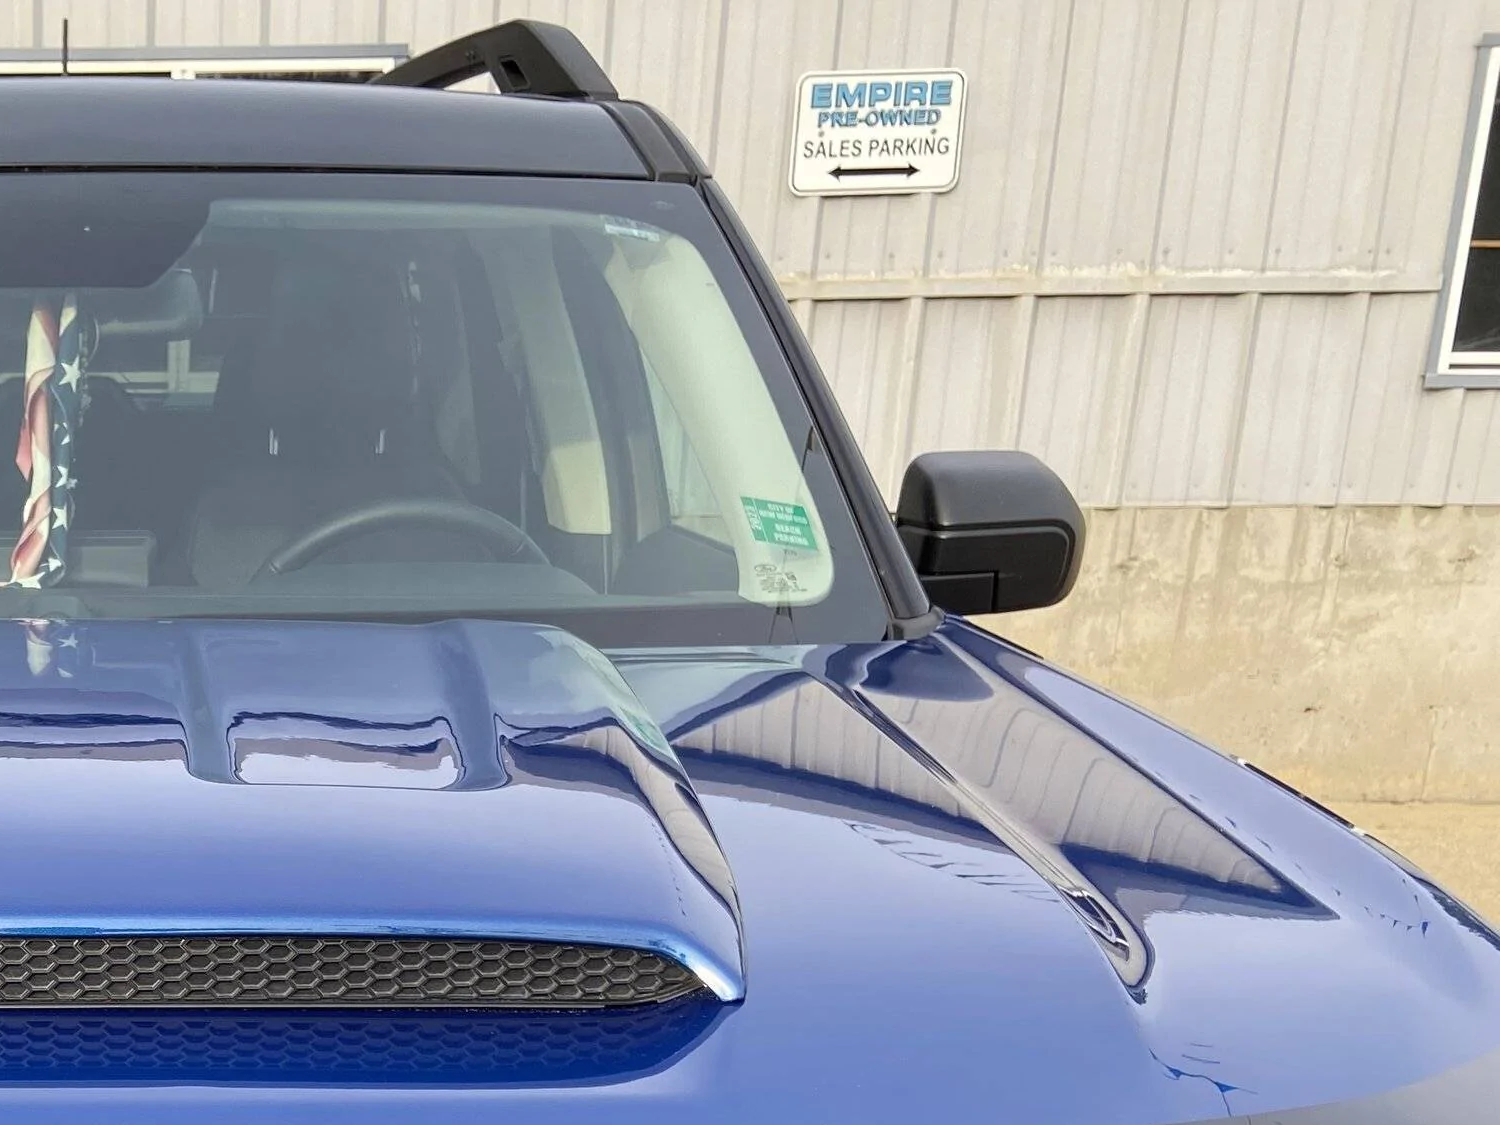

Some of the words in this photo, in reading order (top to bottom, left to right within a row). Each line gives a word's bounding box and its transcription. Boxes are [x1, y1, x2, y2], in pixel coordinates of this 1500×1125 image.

[811, 80, 953, 109] EMPIRE
[817, 109, 942, 128] PRE-OWNED
[803, 140, 863, 159] SALES
[868, 137, 950, 157] PARKING
